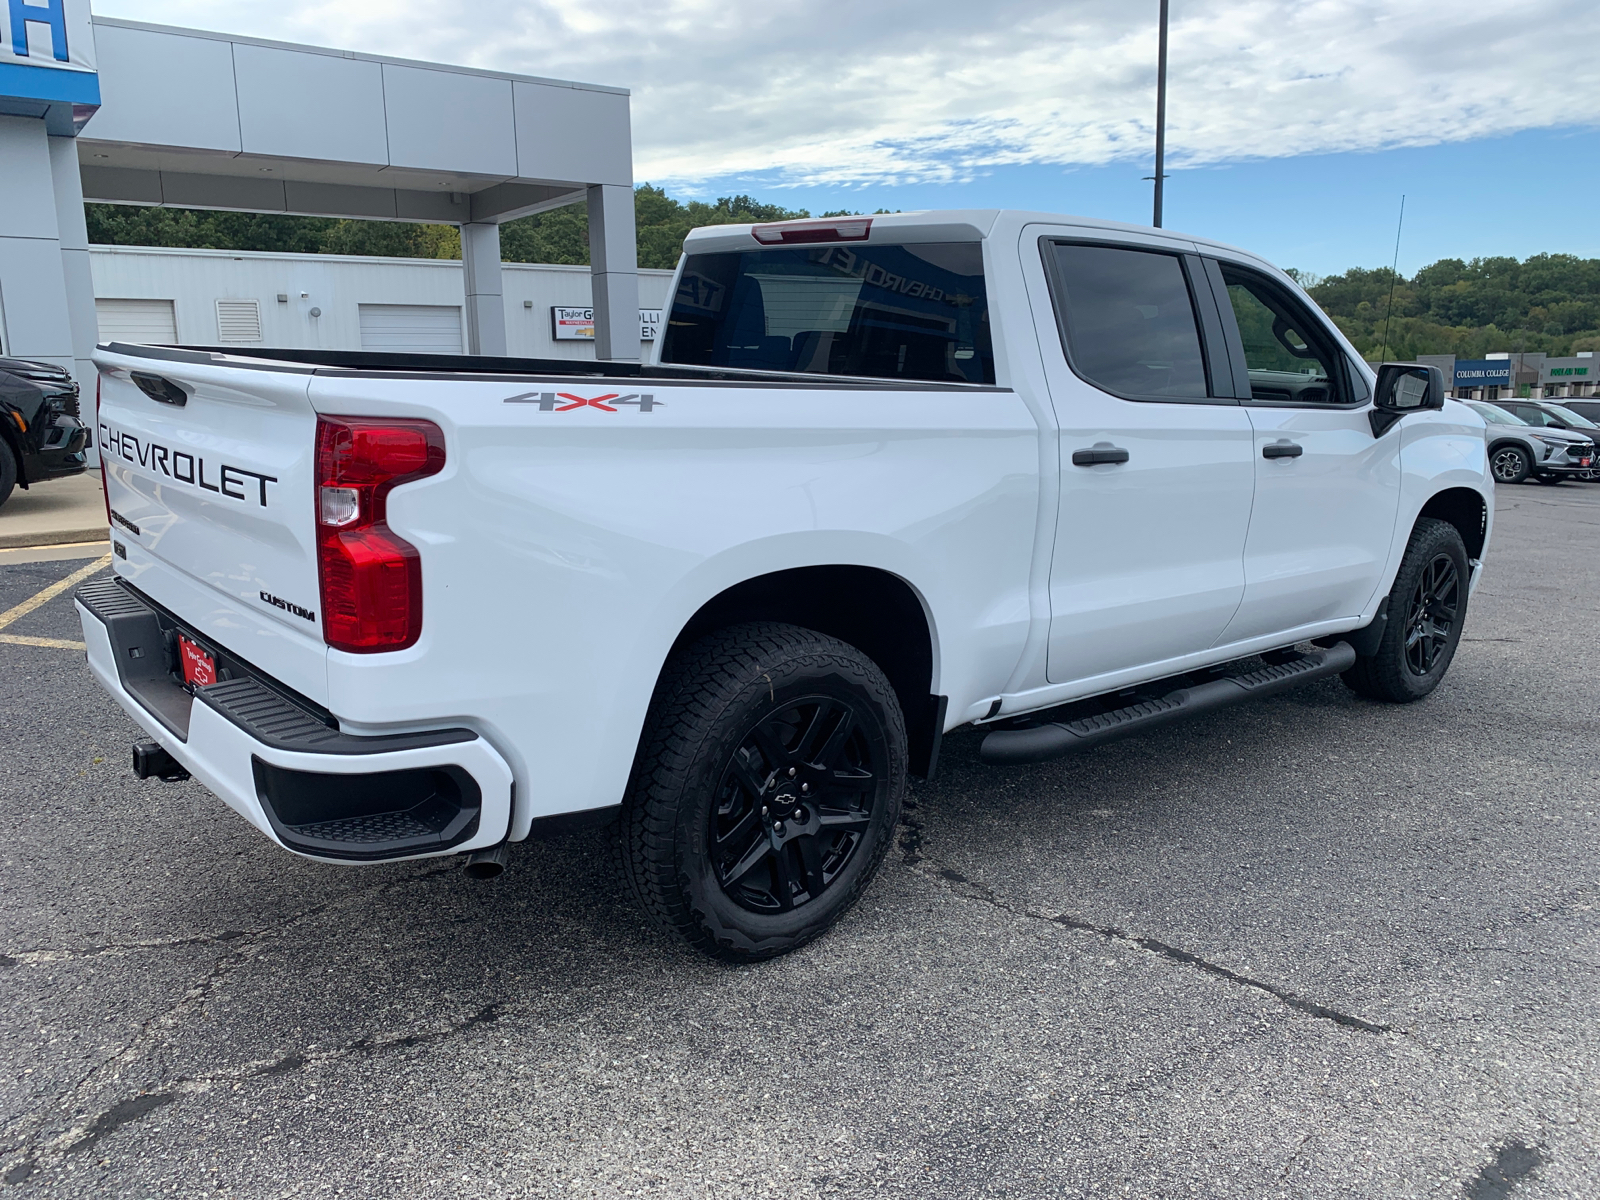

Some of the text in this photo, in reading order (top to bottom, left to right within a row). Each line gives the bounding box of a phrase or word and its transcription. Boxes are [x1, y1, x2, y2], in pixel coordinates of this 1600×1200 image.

[558, 309, 583, 319] Taylor
[639, 312, 660, 324] LLI
[1456, 369, 1509, 379] COLUMBIA COLLEGE
[99, 423, 277, 507] CHEVROLET
[260, 590, 315, 623] CUSTOM
